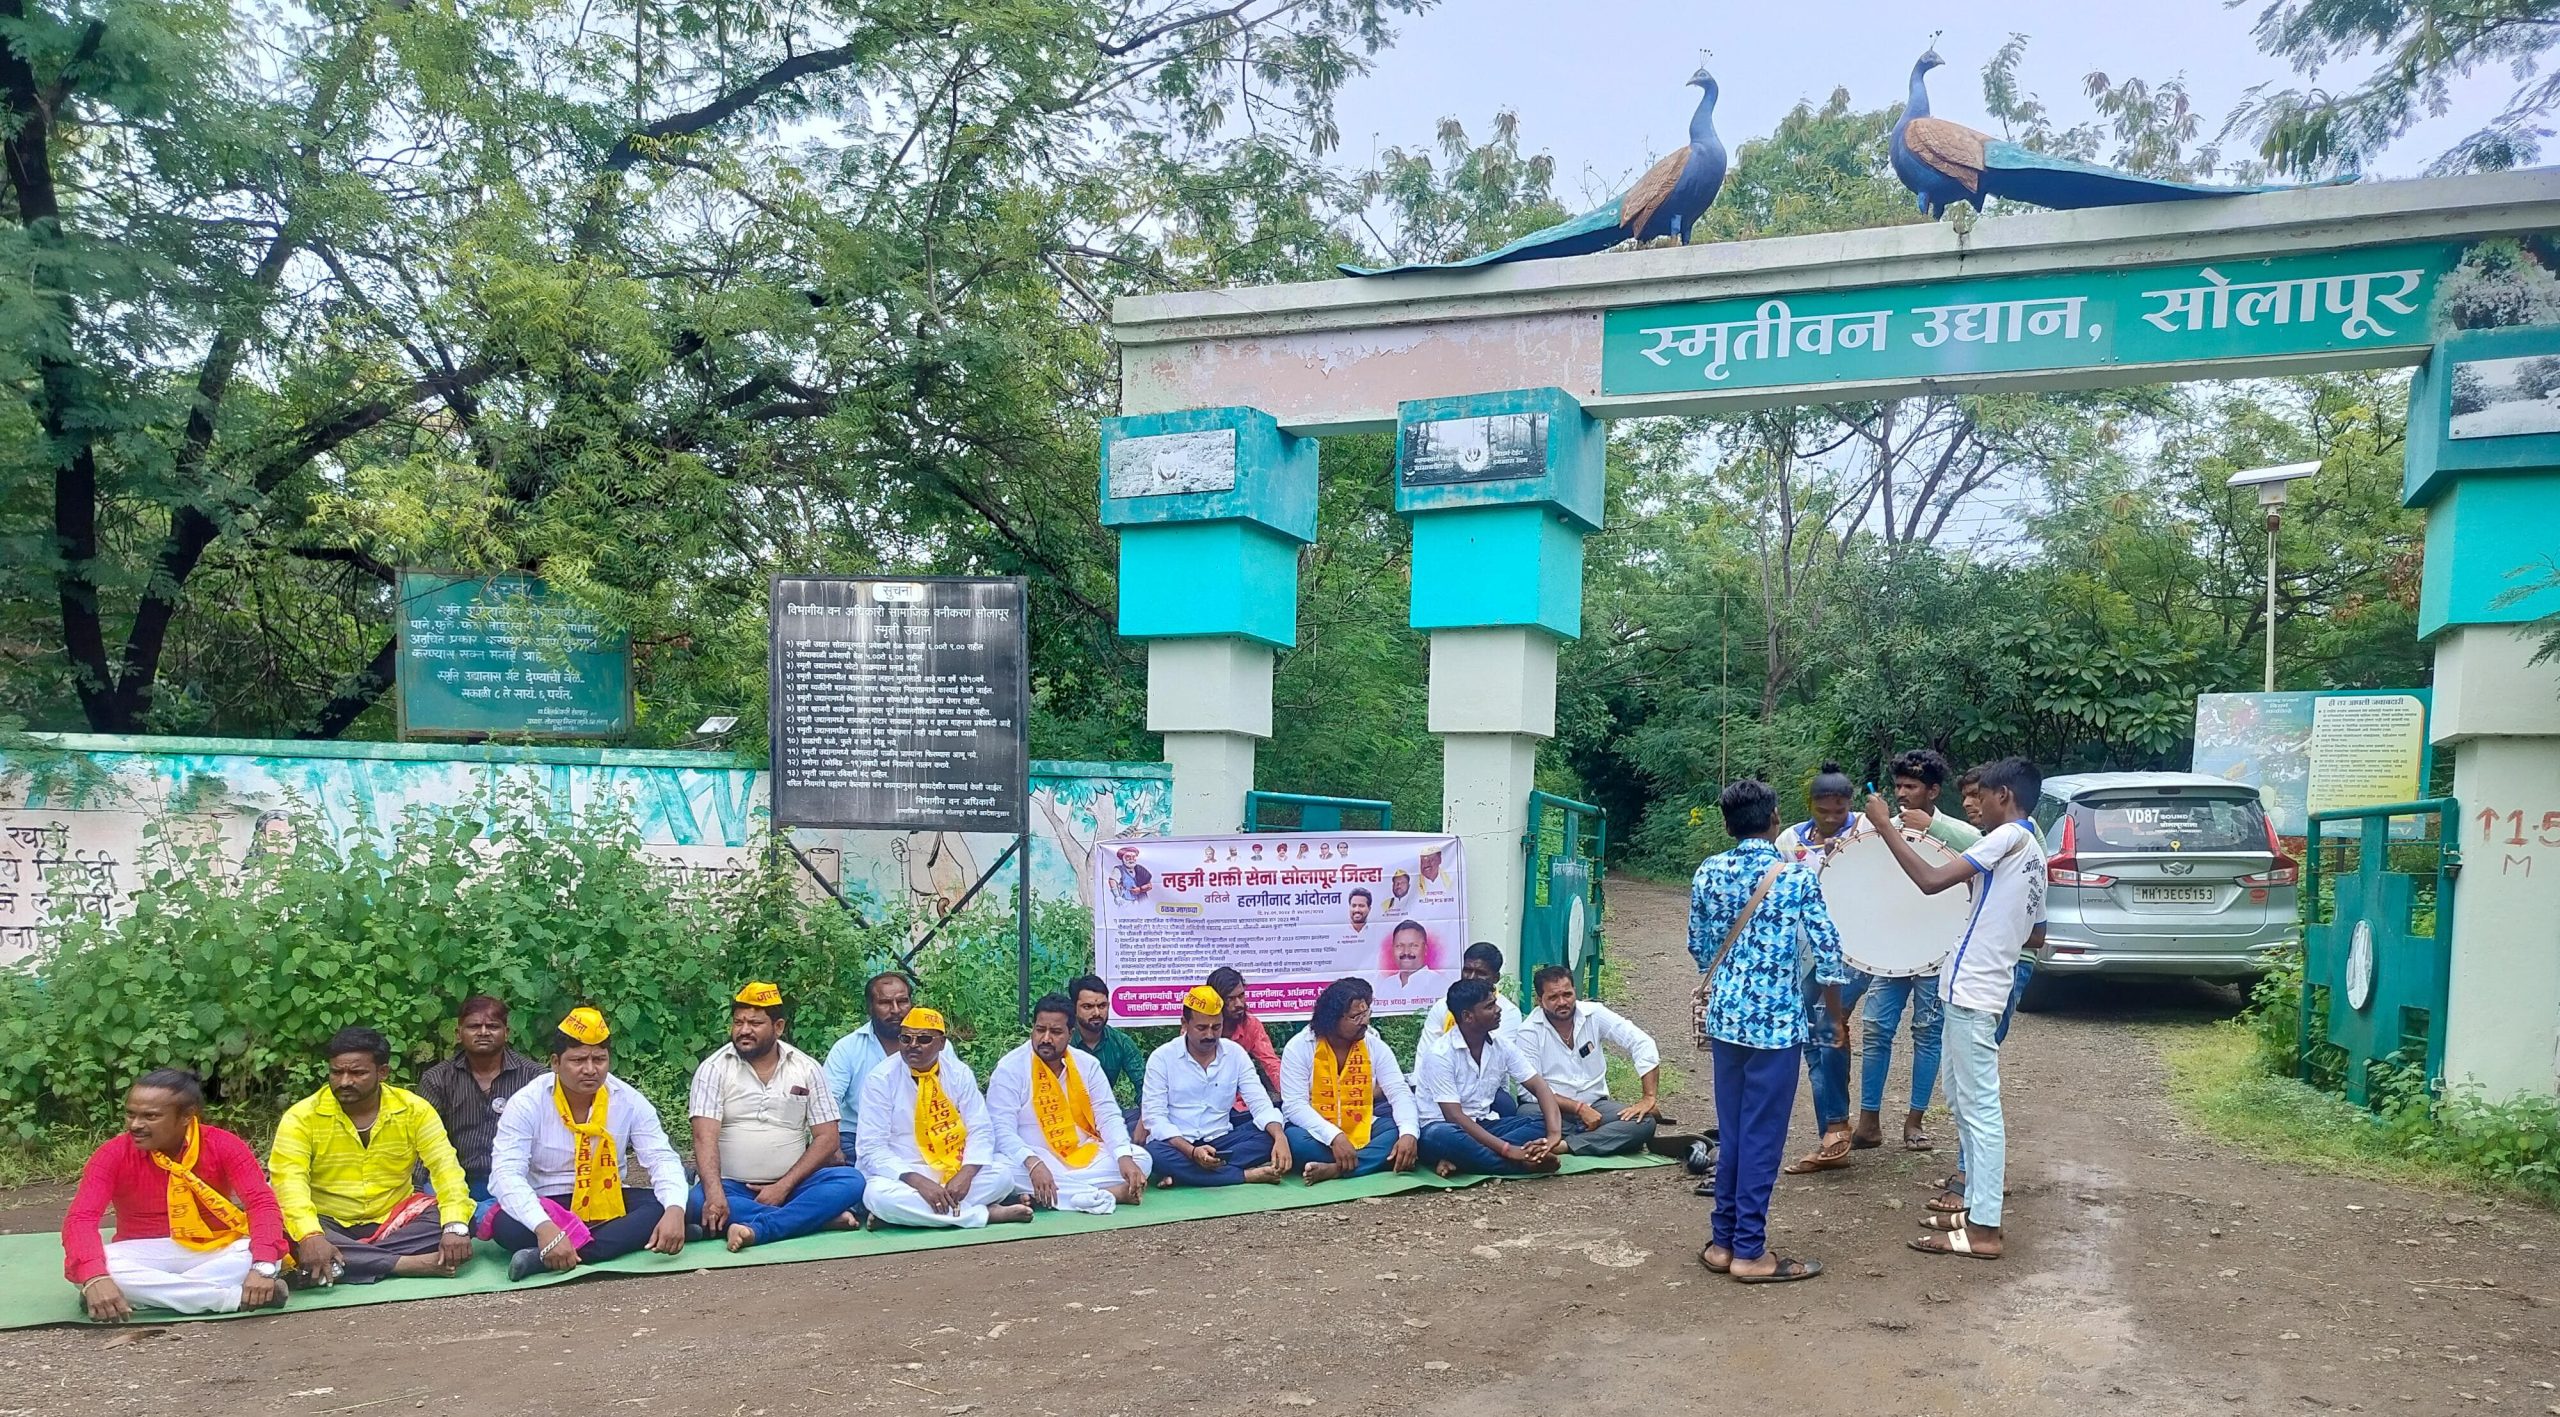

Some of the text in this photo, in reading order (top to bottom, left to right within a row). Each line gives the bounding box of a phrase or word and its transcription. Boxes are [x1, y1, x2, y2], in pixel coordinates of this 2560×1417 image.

[1639, 269, 2425, 381] स्मृतीवन उद्यान, सोलापूर
[883, 586, 912, 600] सुचना
[788, 604, 1009, 622] विभागीय वन अधिकारी सामाजिक वनीकरण सोलापूर
[874, 624, 931, 638] स्मृती उद्यान
[796, 639, 811, 649] स्मृती
[464, 671, 501, 684] उद्यानास
[526, 669, 560, 684] देण्याची
[461, 687, 491, 699] सकाळी
[494, 690, 500, 698] ८
[503, 686, 511, 698] ते
[915, 796, 946, 806] विभागीय
[963, 797, 996, 807] अधिकारी
[2126, 809, 2159, 824] VD87
[2502, 854, 2532, 878] M
[1161, 864, 1383, 892] लहुजी शक्ती सेना सोलापूर जिल्हा
[1238, 891, 1291, 909] हलगीनाद
[1295, 890, 1342, 907] आंदोलन
[2141, 888, 2213, 900] MH13EC5153
[1118, 991, 1137, 1000] वरील
[1282, 1000, 1299, 1009] चालू
